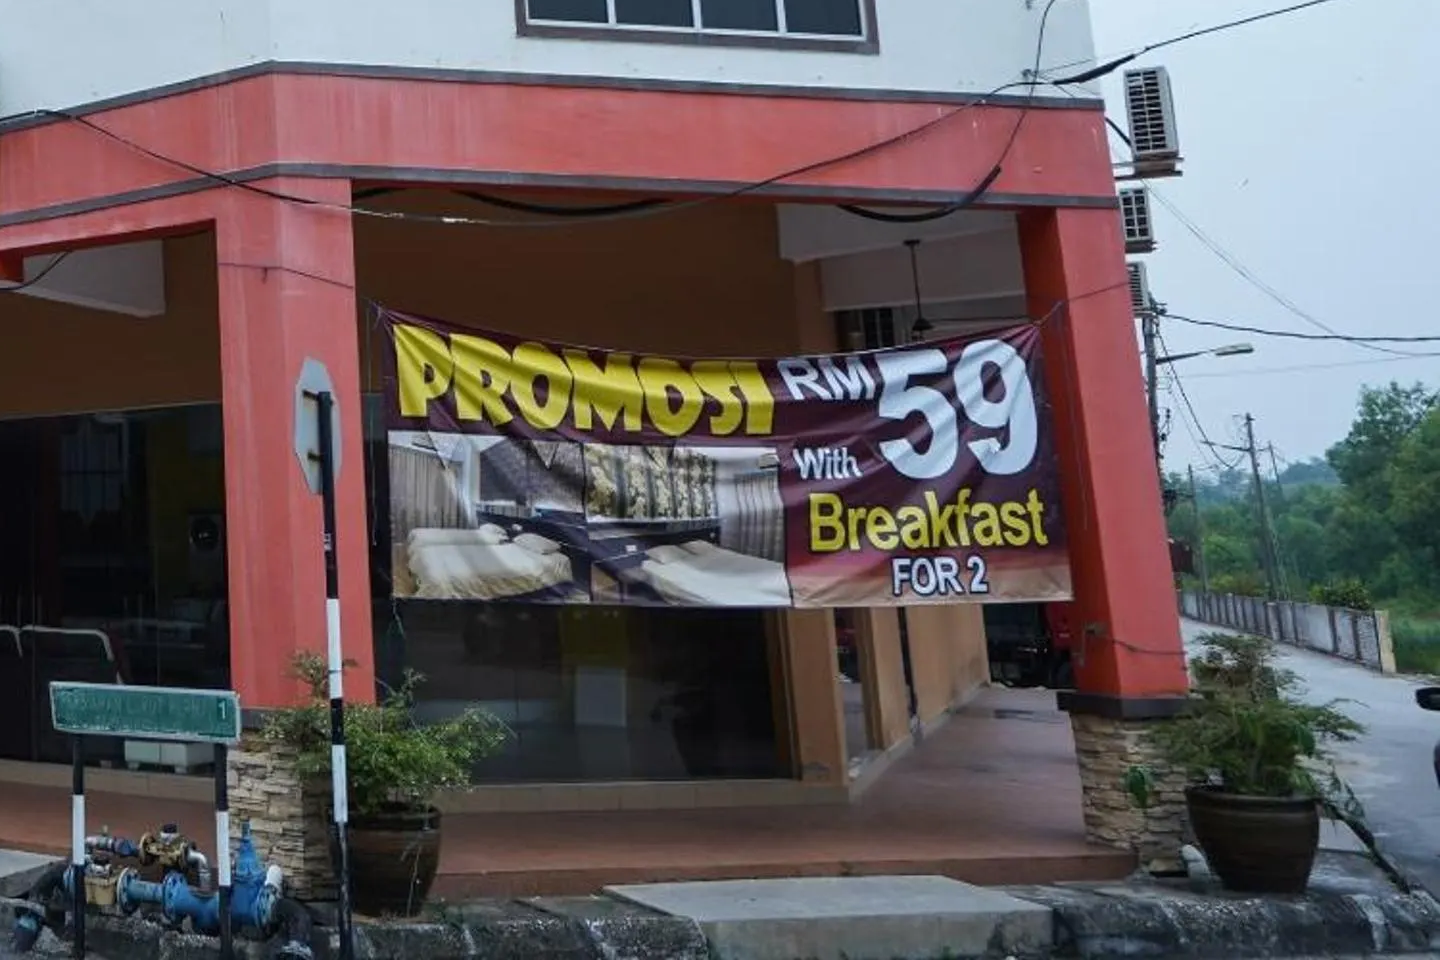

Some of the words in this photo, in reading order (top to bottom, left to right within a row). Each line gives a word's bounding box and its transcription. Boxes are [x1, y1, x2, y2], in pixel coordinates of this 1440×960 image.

[393, 324, 776, 437] PROMOSI
[793, 446, 863, 480] With
[809, 488, 1049, 552] Breakfast
[892, 555, 963, 596] FOR
[966, 554, 989, 594] 2
